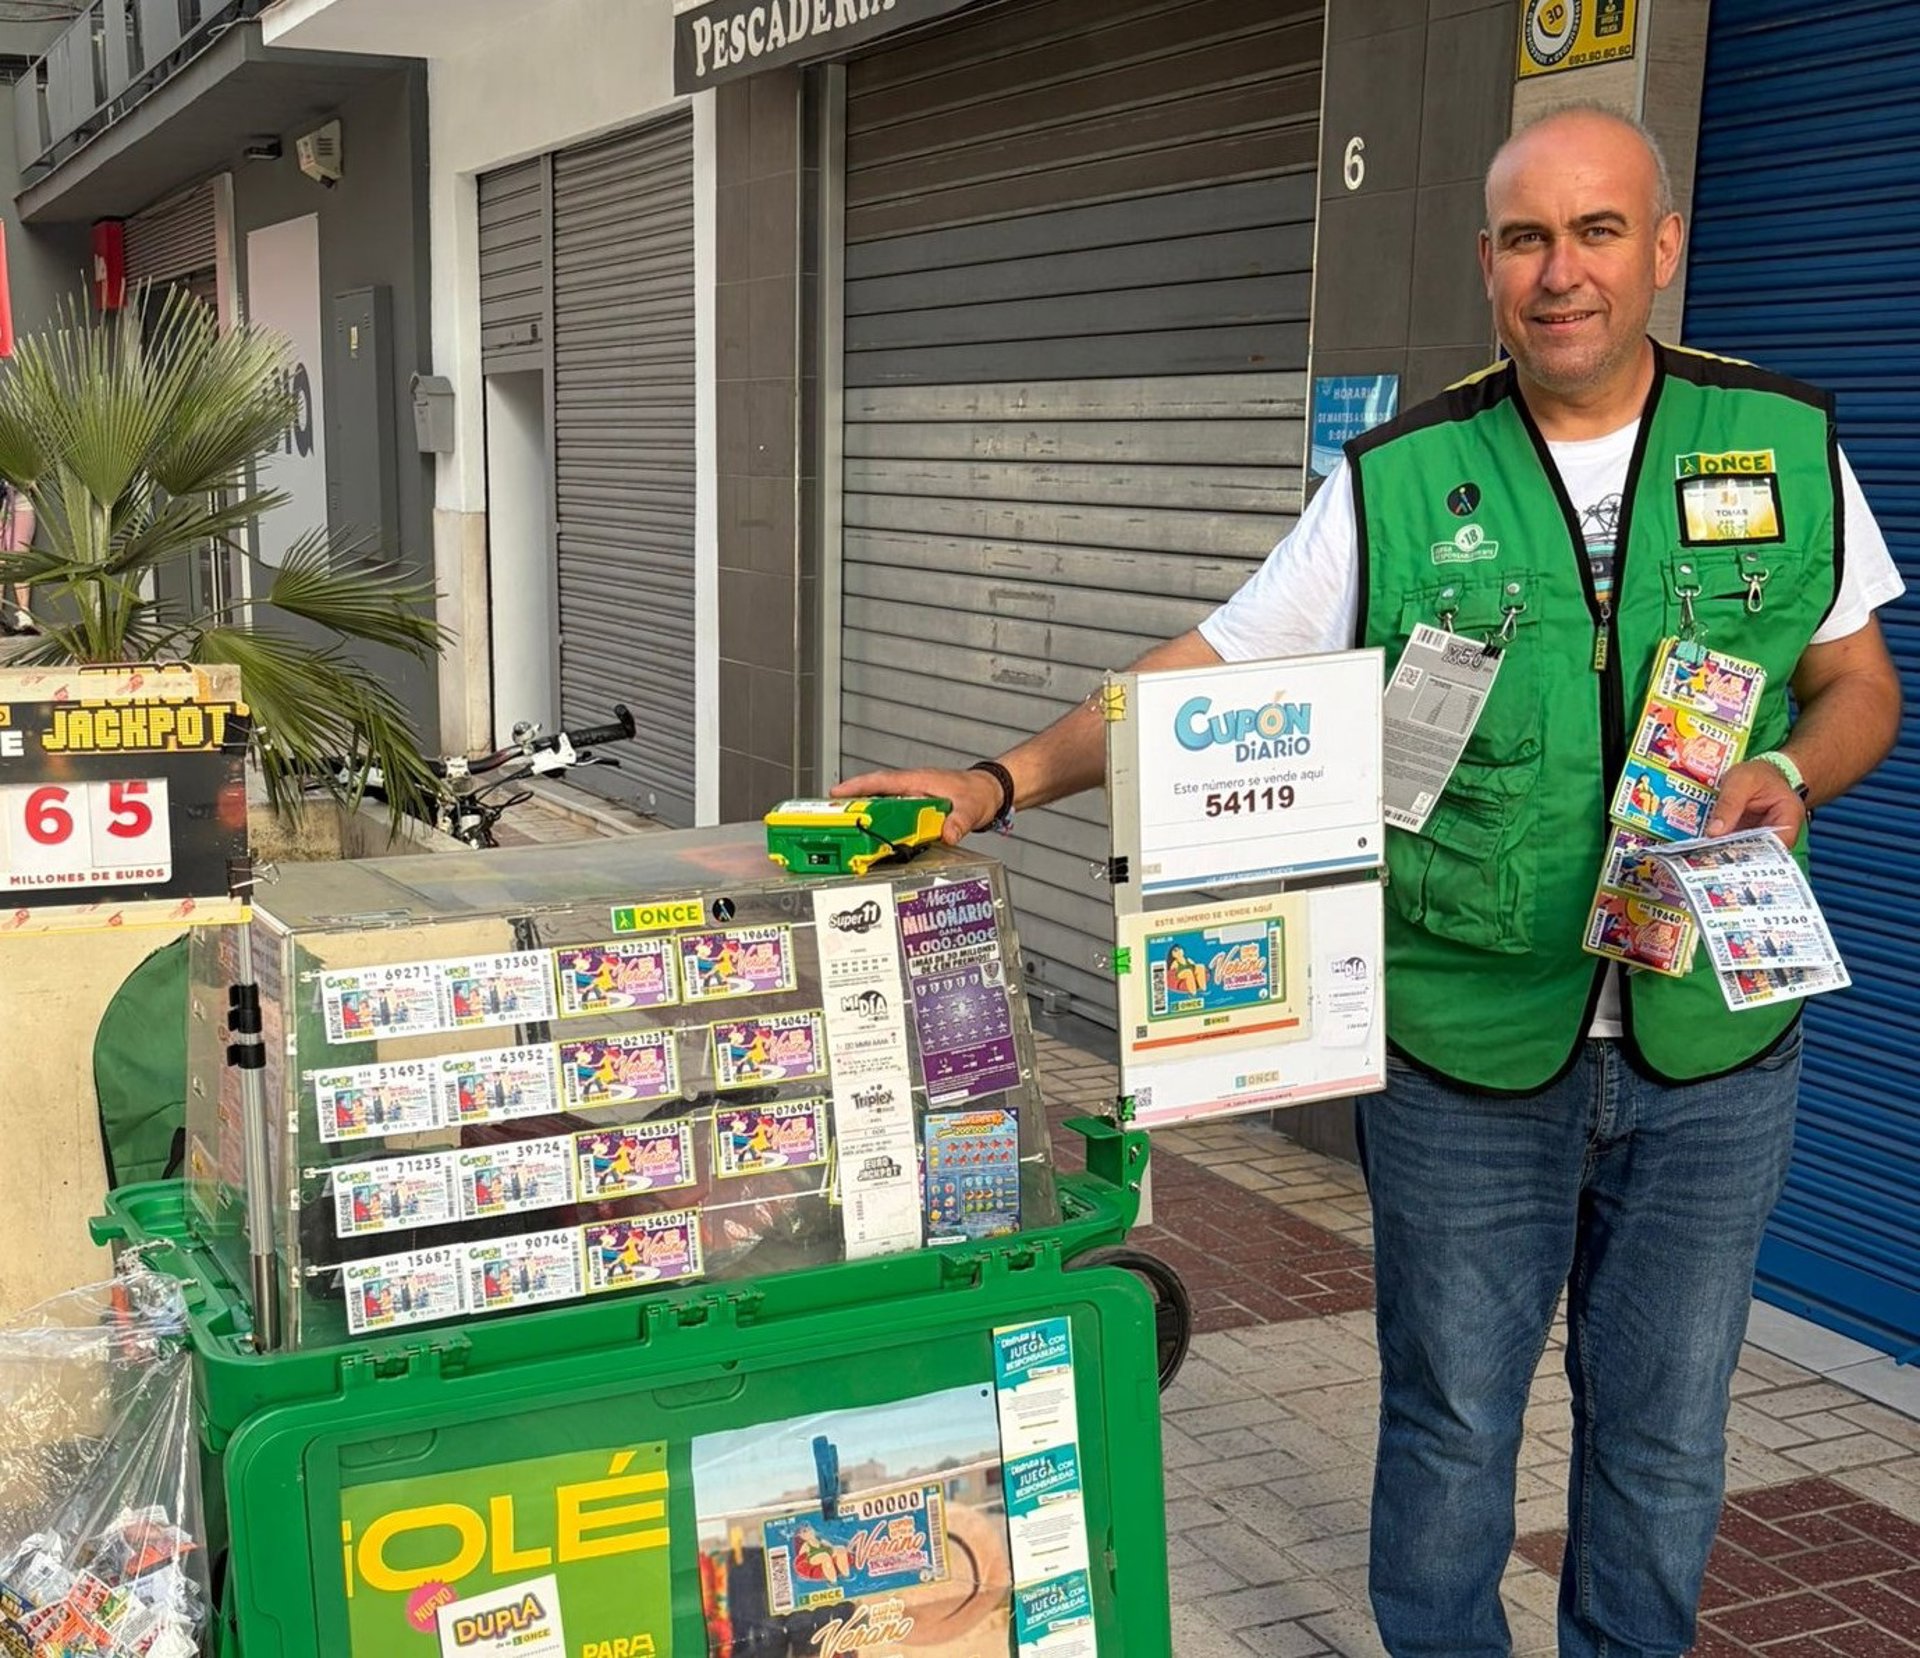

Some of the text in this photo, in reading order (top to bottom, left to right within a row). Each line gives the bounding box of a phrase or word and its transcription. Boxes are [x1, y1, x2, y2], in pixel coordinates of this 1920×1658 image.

[1545, 4, 1565, 25] 3D
[692, 0, 897, 76] PESCADER
[1344, 136, 1365, 190] 6
[1704, 455, 1768, 473] ONCE
[41, 705, 232, 750] JACKPOT
[1173, 766, 1325, 796] Este número se vende aquí
[1205, 785, 1296, 818] 54119
[10, 868, 165, 885] MILLONES DE EUROS
[925, 888, 969, 910] Mega
[640, 905, 699, 925] ONCE
[903, 900, 993, 936] MILLONARIO
[1155, 903, 1273, 928] ESTE NÚMERO SE VENDE AQUÍ
[741, 928, 778, 942] 19640
[385, 965, 431, 981] 69271
[859, 992, 888, 1018] DÍA
[1180, 999, 1203, 1010] ONCE
[773, 1014, 810, 1029] 34042
[623, 1032, 661, 1047] 62123
[500, 1049, 544, 1064] 43952
[379, 1063, 425, 1080] 51493
[776, 1101, 812, 1116] 07694
[516, 1142, 561, 1158] 39724
[396, 1157, 442, 1174] 71235
[647, 1214, 685, 1230] 54507
[524, 1233, 569, 1250] 90746
[407, 1249, 451, 1268] 15687
[1049, 1334, 1066, 1346] CON
[1057, 1459, 1074, 1471] CON
[839, 1491, 921, 1518] 000 00000
[850, 1520, 925, 1569] Verano
[811, 1589, 842, 1602] ONCE
[1068, 1586, 1086, 1599] CON
[413, 1586, 452, 1624] NUEVO
[455, 1594, 543, 1645] DUPLA
[523, 1629, 551, 1644] ONCE
[811, 1604, 914, 1658] Verano
